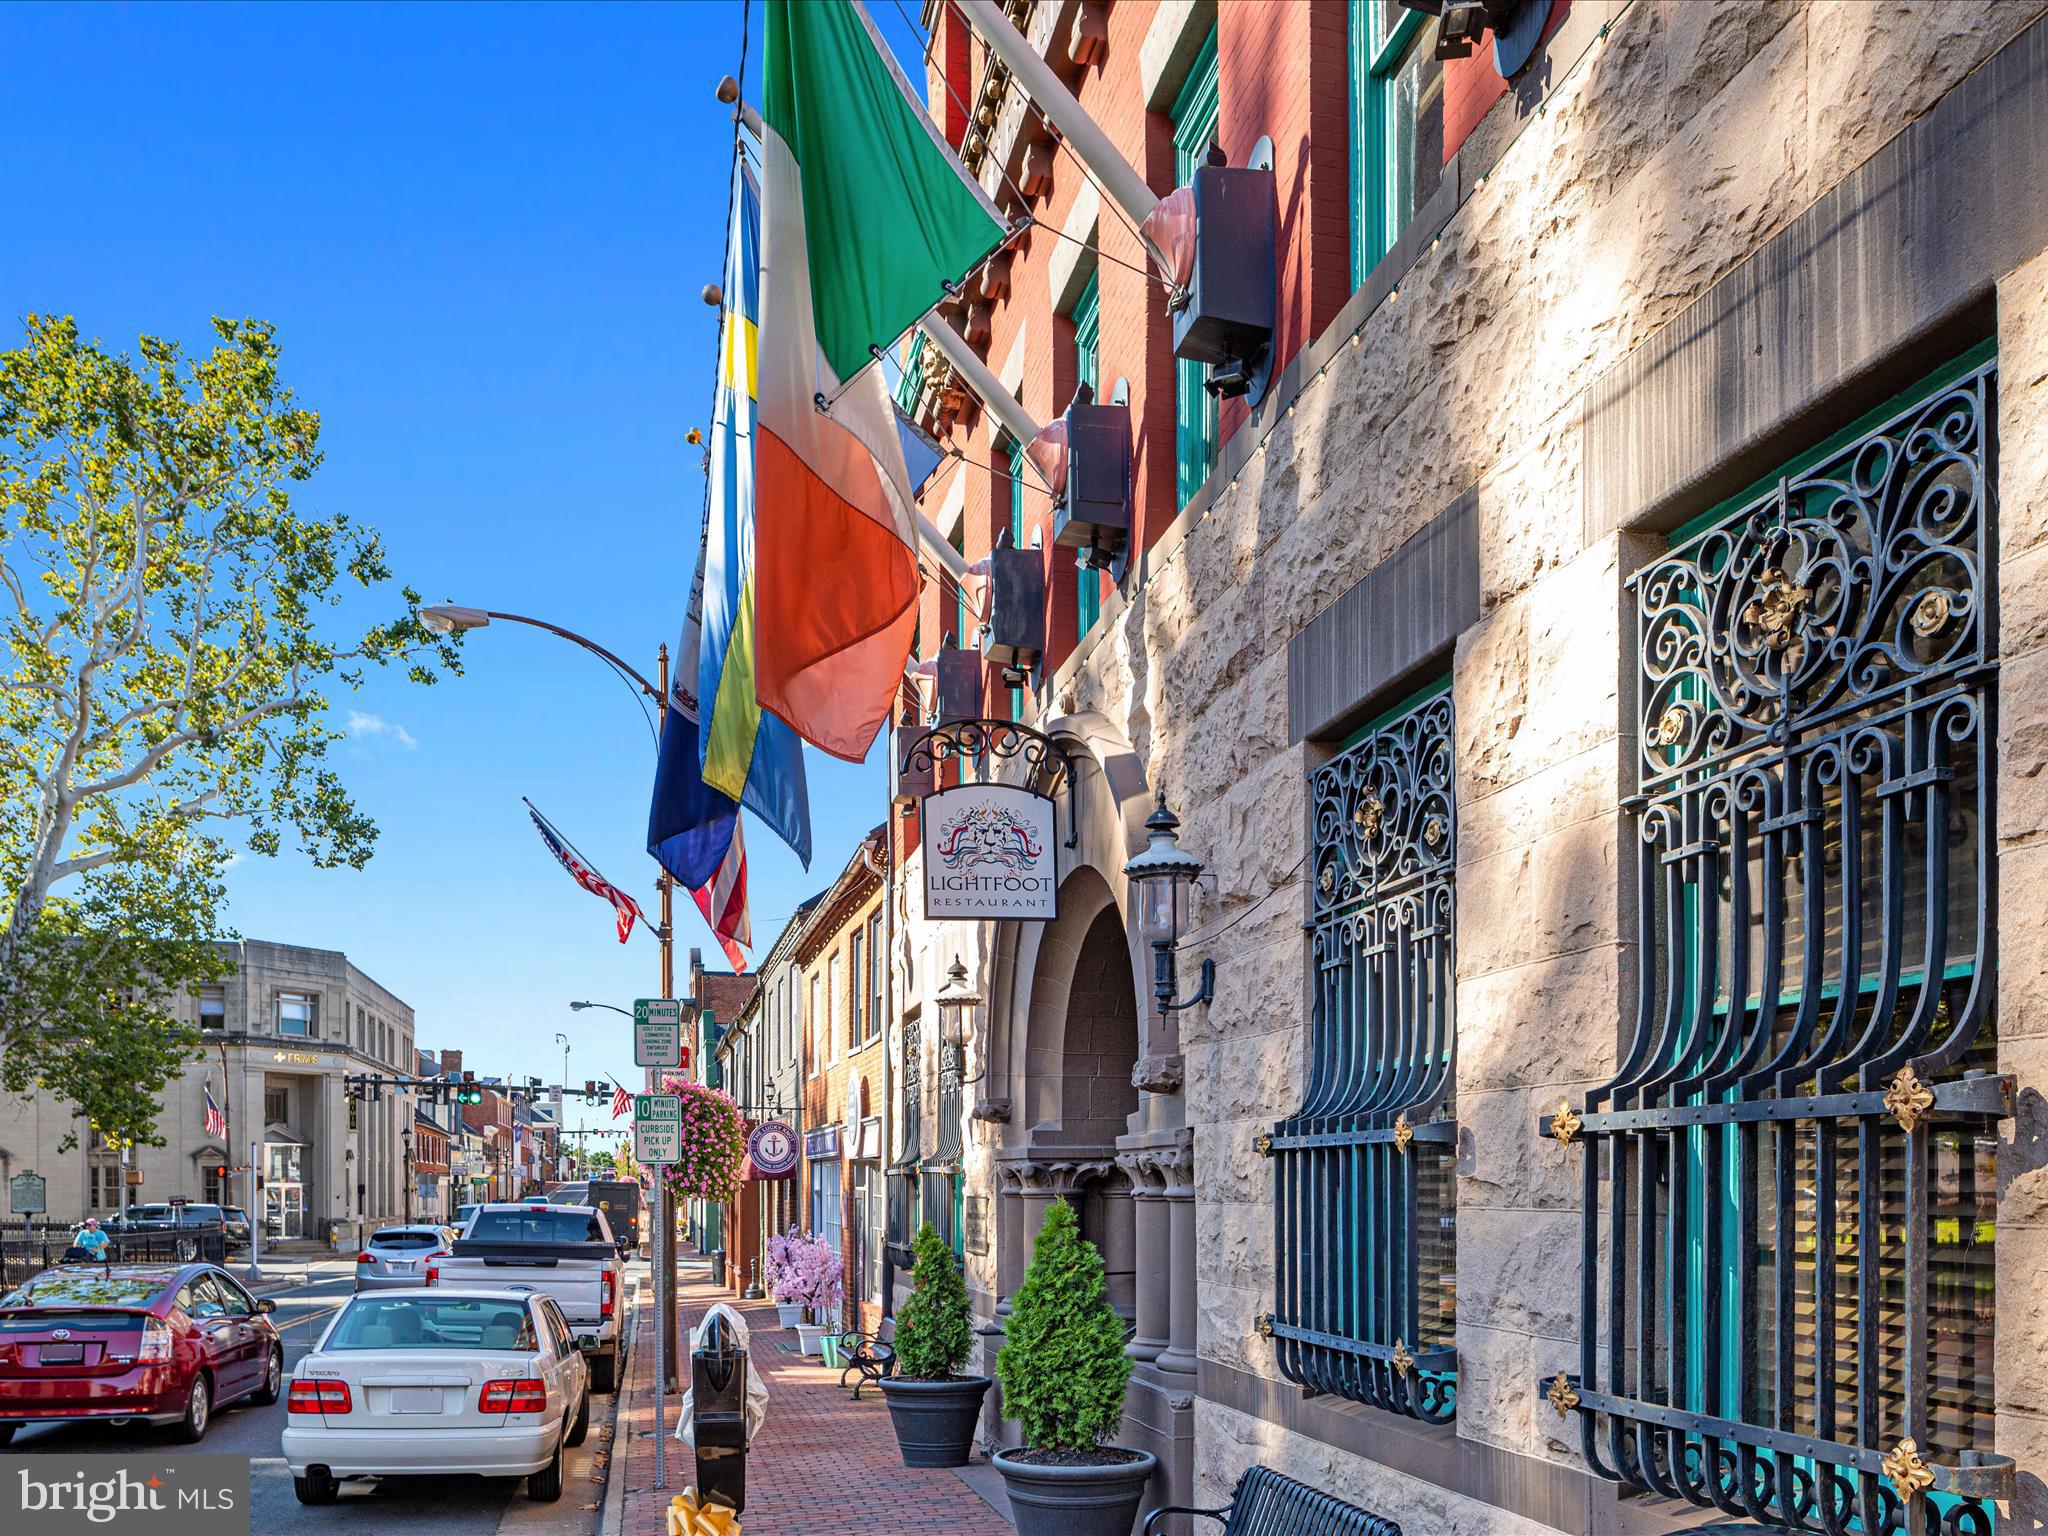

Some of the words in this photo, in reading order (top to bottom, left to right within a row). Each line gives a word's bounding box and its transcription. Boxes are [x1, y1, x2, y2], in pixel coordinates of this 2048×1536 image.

[931, 876, 1052, 892] LIGHTFOOT
[934, 898, 1048, 907] RESTAURANT
[636, 1006, 648, 1018] 20
[649, 1008, 677, 1017] MINUTES
[636, 1101, 650, 1117] 10
[654, 1100, 675, 1108] MINUTE
[653, 1110, 677, 1119] PARKING
[641, 1125, 675, 1133] CURBSIDE
[753, 1129, 762, 1141] THE
[762, 1125, 782, 1133] LUCKY
[783, 1128, 795, 1141] KNOT
[644, 1137, 660, 1145] PICK
[662, 1137, 671, 1145] UP
[649, 1148, 667, 1157] ONLY
